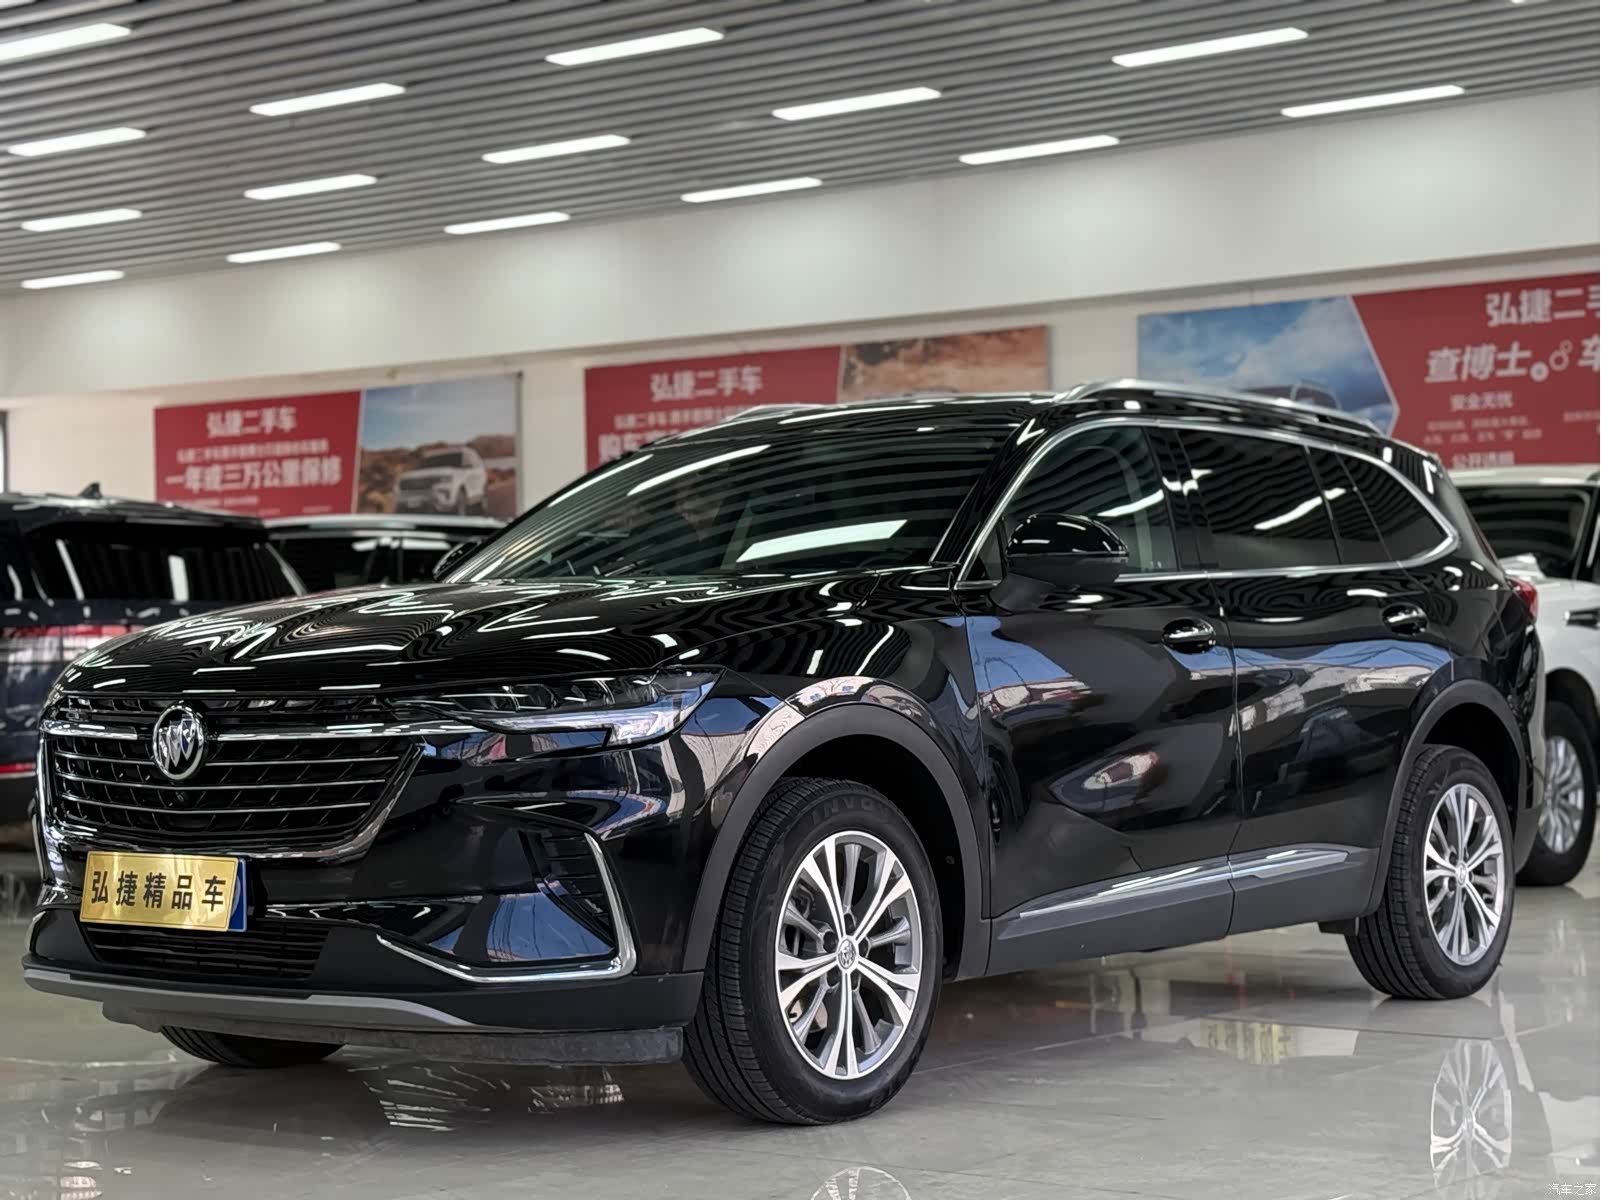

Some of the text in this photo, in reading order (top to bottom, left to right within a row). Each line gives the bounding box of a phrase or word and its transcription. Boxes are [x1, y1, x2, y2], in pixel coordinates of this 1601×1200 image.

[650, 365, 762, 403] 弘捷二手车
[206, 405, 297, 439] 弘捷二手车
[91, 870, 226, 912] 弘捷精品车
